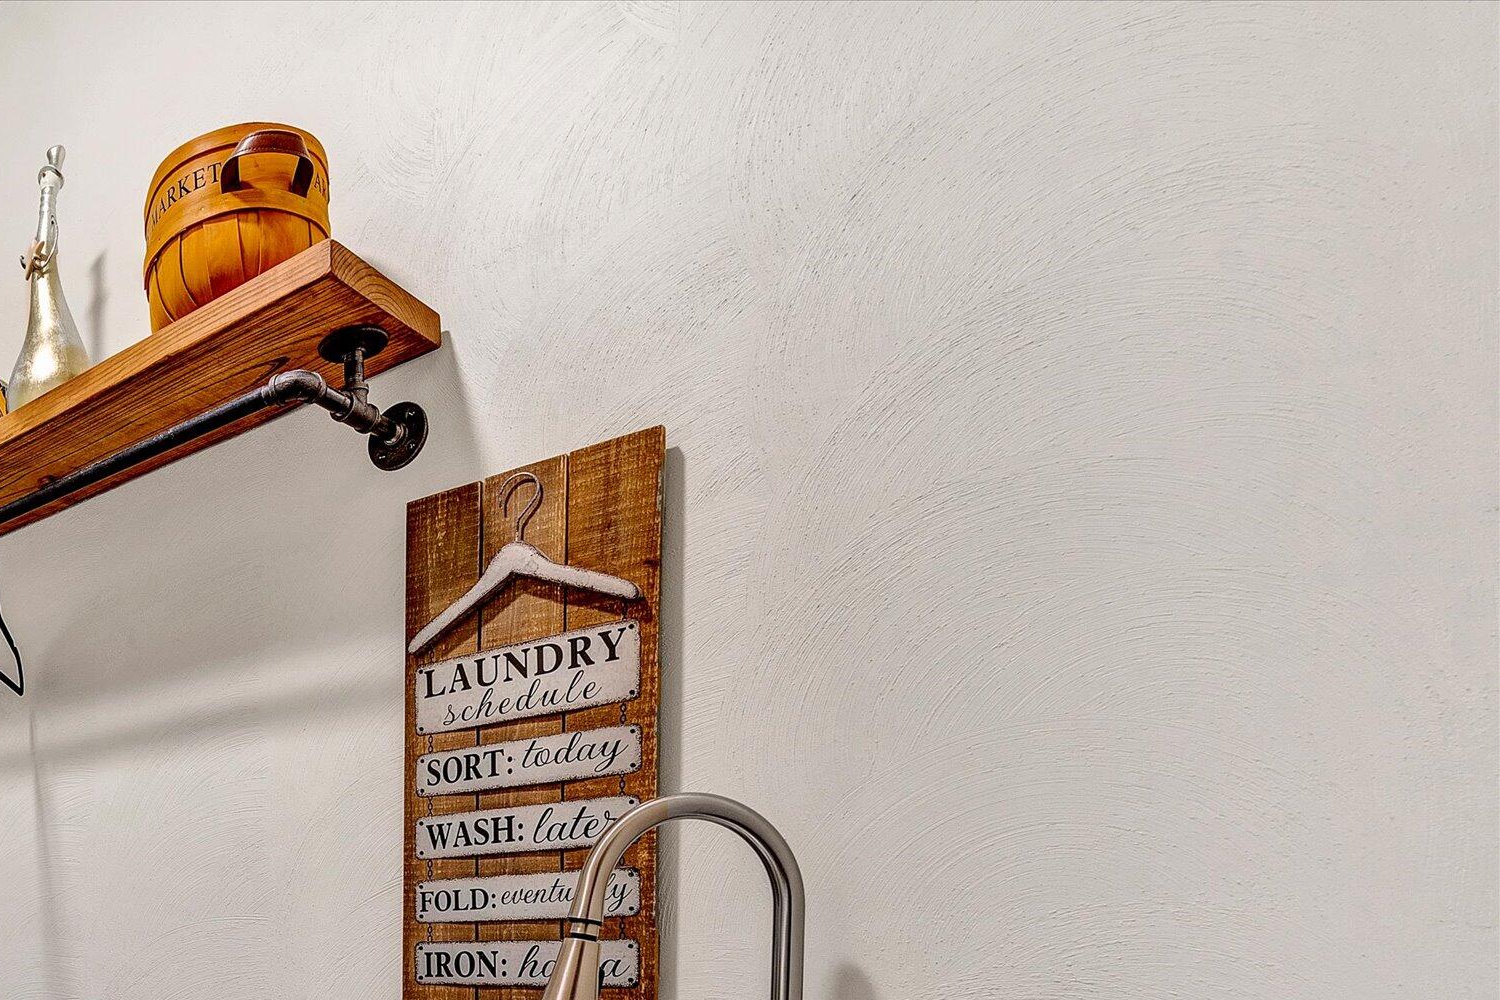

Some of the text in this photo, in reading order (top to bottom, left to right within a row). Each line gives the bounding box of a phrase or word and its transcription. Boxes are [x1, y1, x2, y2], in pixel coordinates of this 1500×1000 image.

[150, 162, 222, 227] MARKET
[424, 627, 626, 699] LAUNDRY
[443, 669, 602, 726] schedule
[427, 731, 629, 787] SORT: today
[426, 806, 618, 850] WASH: later
[419, 888, 497, 913] FOLD:
[424, 951, 508, 978] IRON:
